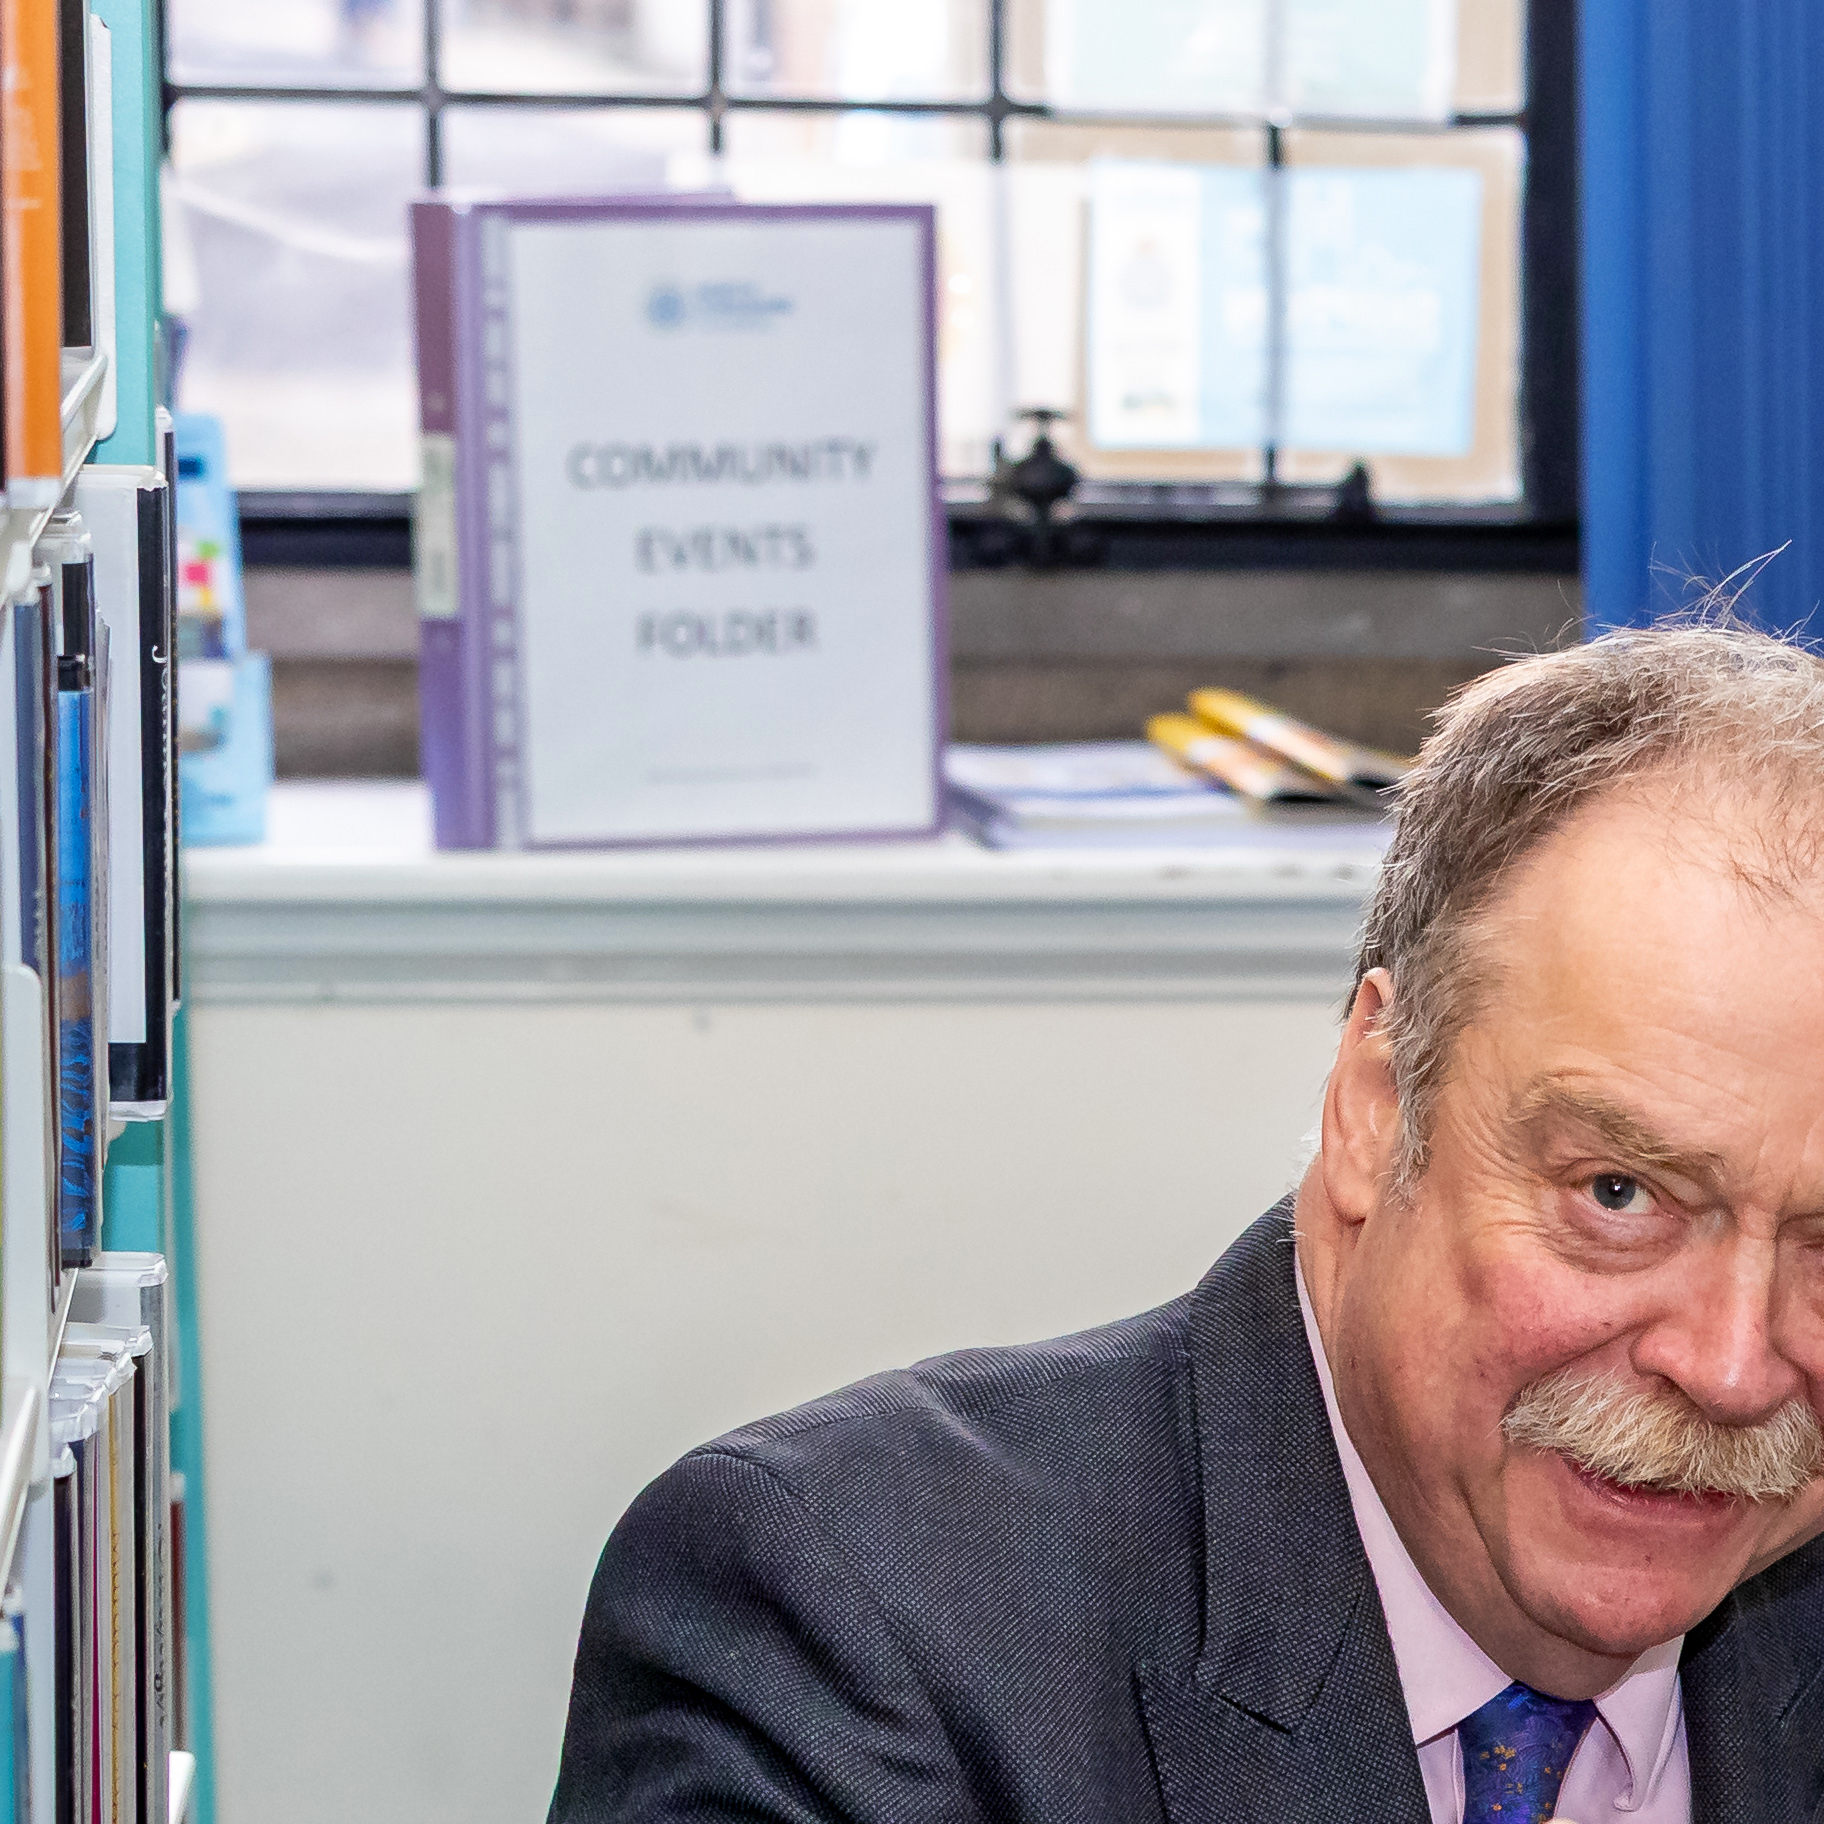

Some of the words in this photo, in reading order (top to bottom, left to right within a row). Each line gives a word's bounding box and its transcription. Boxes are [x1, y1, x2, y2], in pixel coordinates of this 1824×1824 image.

[566, 436, 876, 490] COMMUNITY
[634, 524, 816, 575] EVENTS
[634, 607, 818, 659] FOLDER
